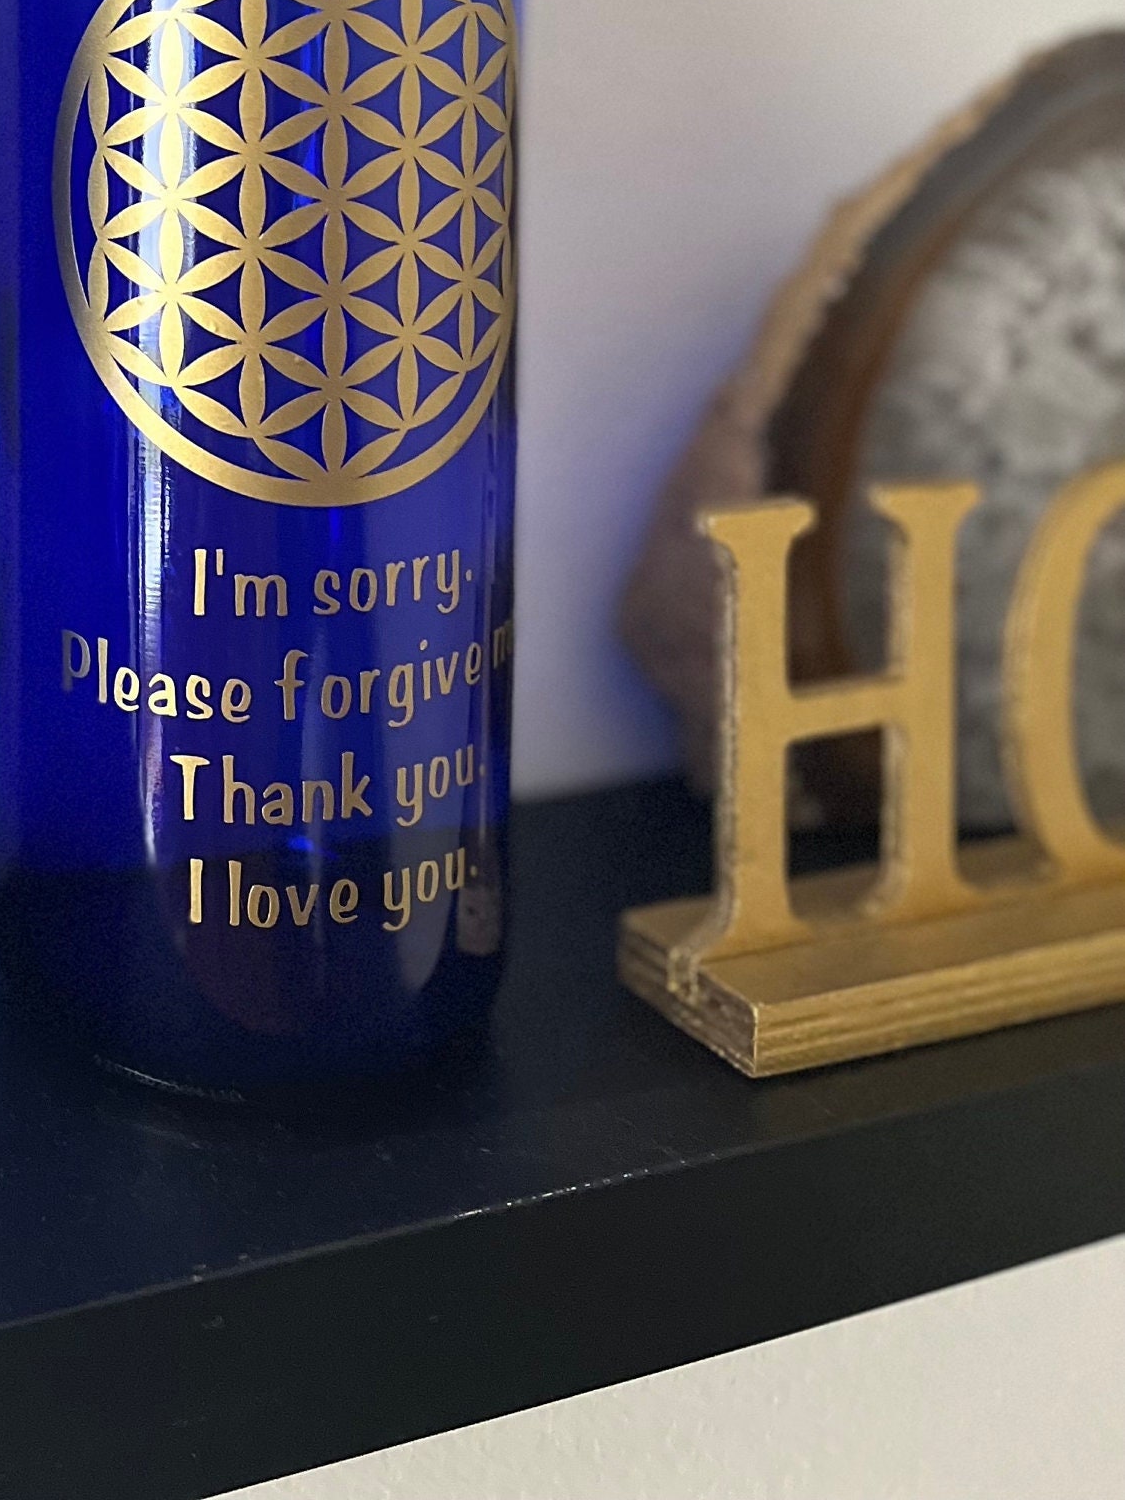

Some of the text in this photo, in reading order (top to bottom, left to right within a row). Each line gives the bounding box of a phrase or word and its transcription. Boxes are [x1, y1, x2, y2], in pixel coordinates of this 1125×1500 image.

[192, 547, 474, 617] I'm sorry.
[60, 629, 253, 724] Please
[273, 637, 483, 729] forgive
[169, 743, 487, 828] Thank you.
[188, 846, 478, 932] I love you.
